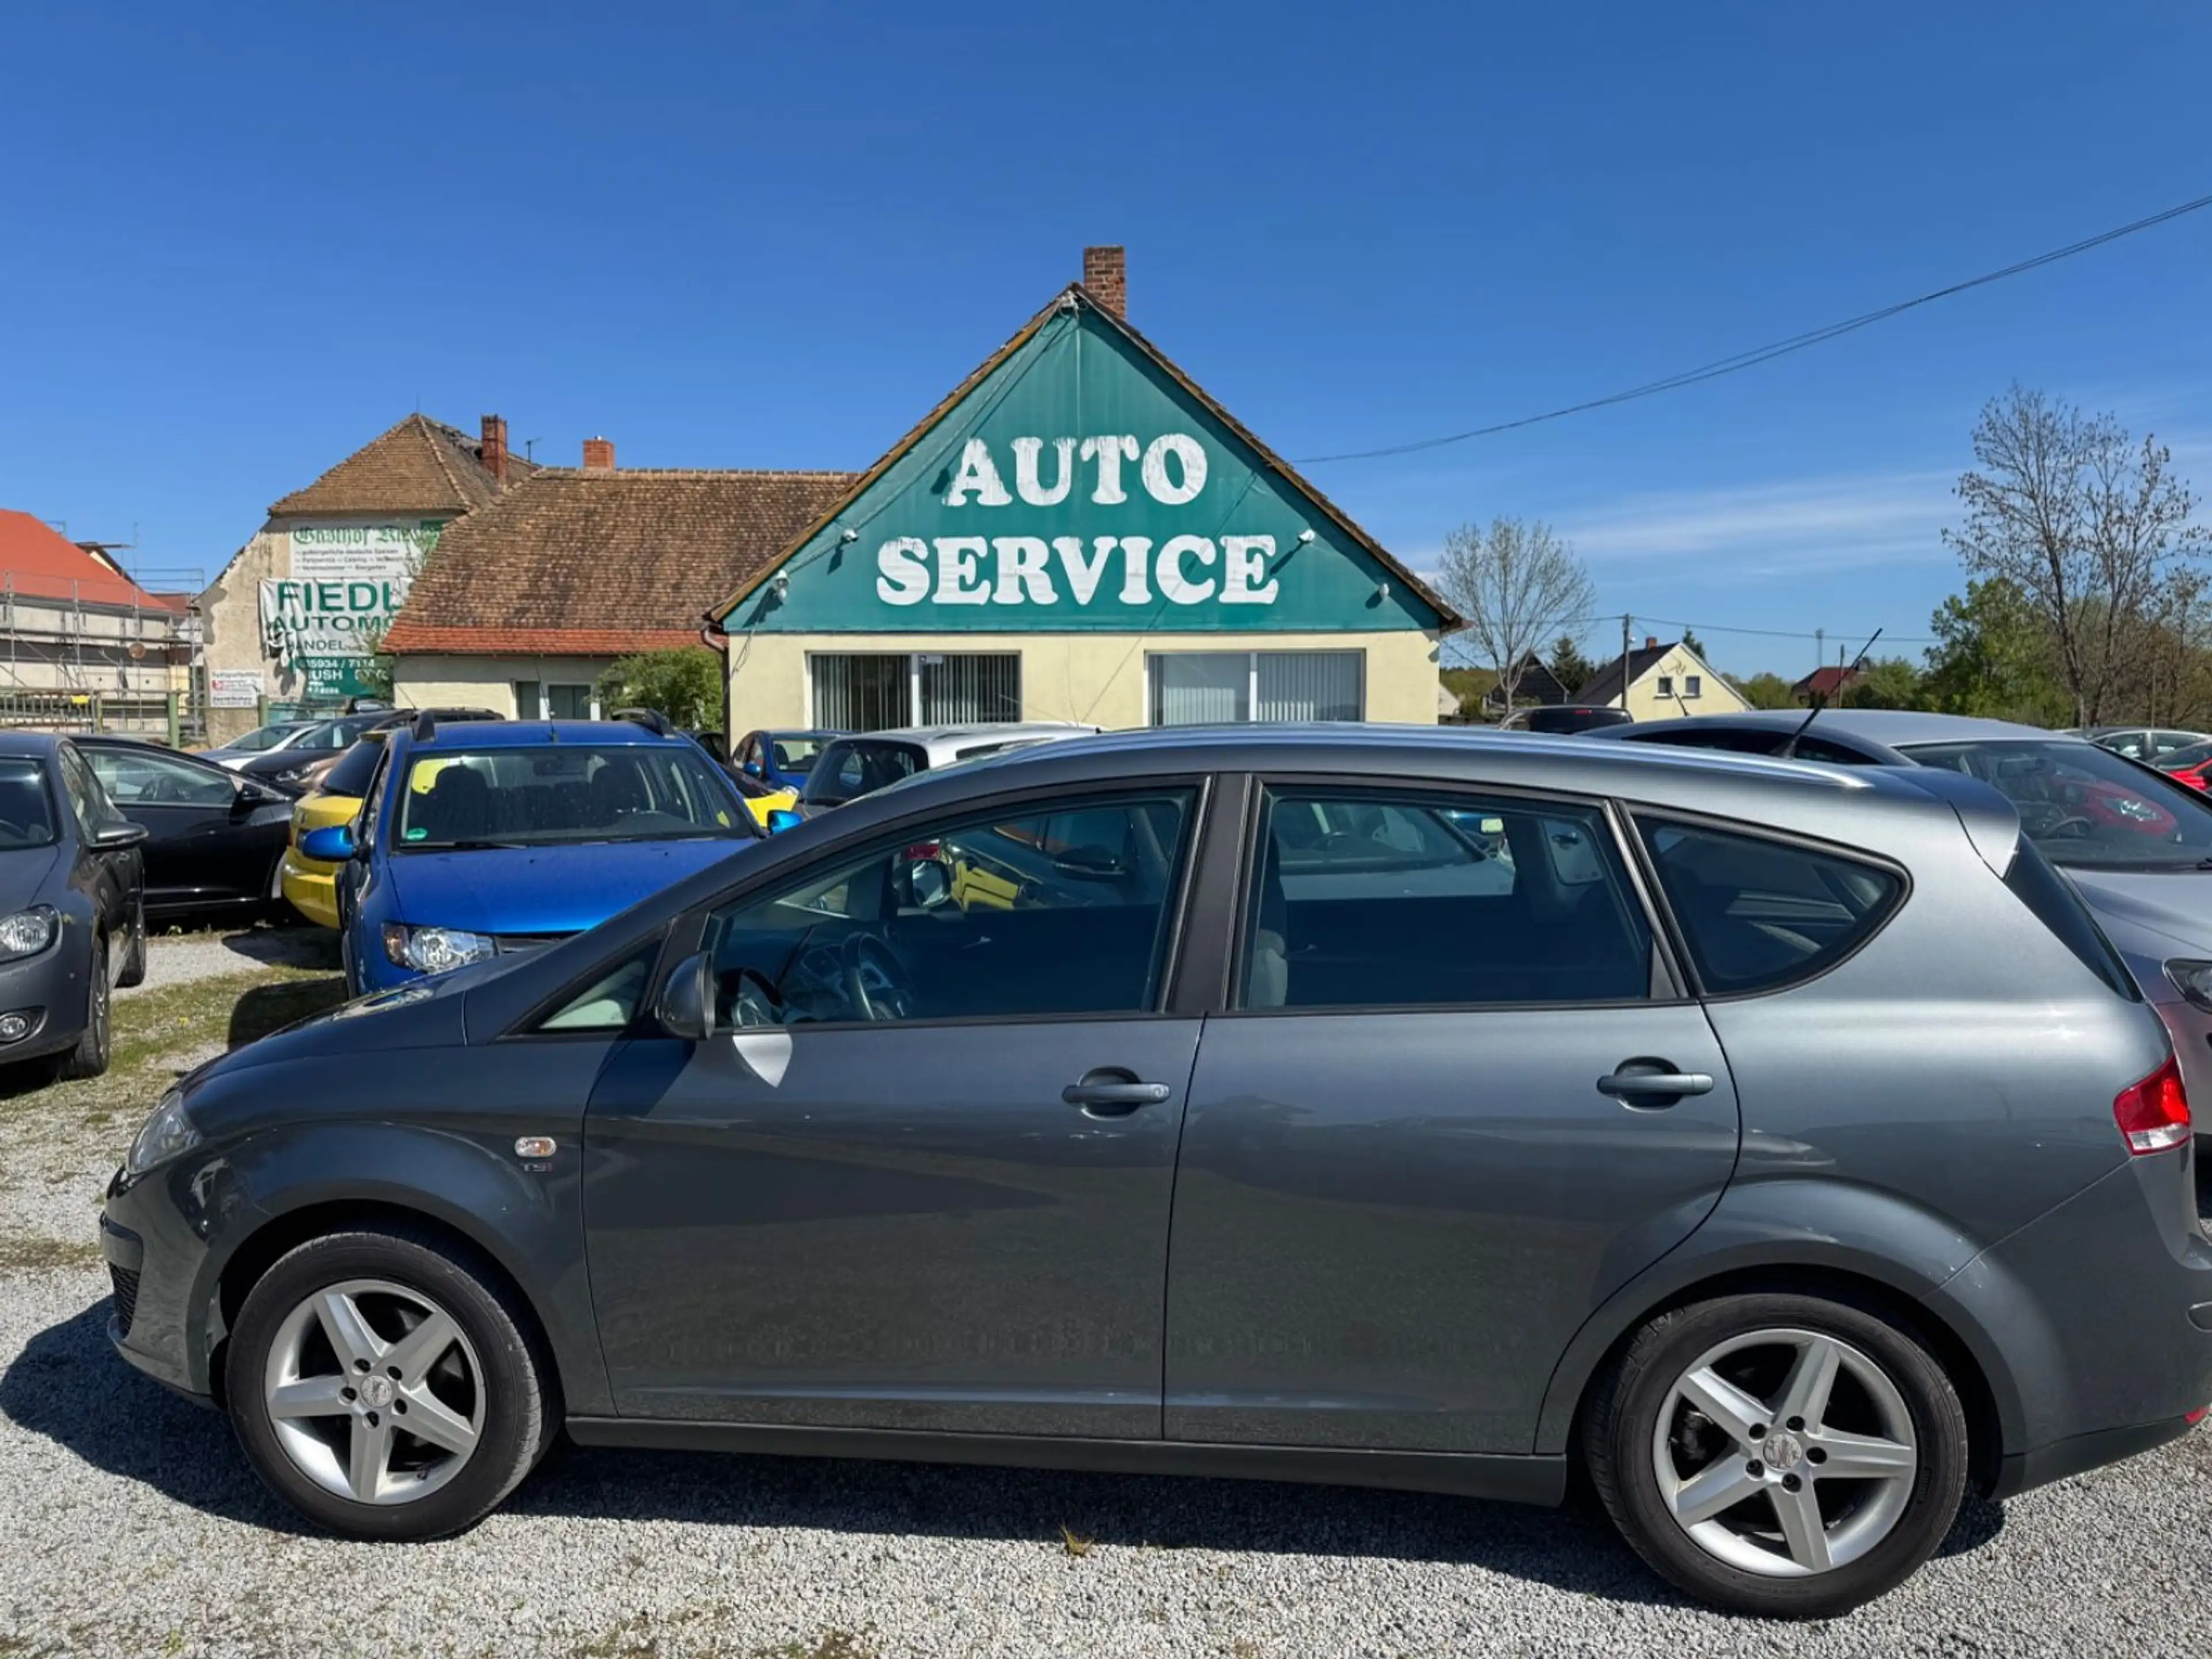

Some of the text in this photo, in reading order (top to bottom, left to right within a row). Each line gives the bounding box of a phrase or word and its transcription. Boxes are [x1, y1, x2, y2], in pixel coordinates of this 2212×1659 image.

[942, 433, 1207, 507] AUTO
[277, 582, 402, 612] FIEDL
[876, 535, 1278, 606] SERVICE
